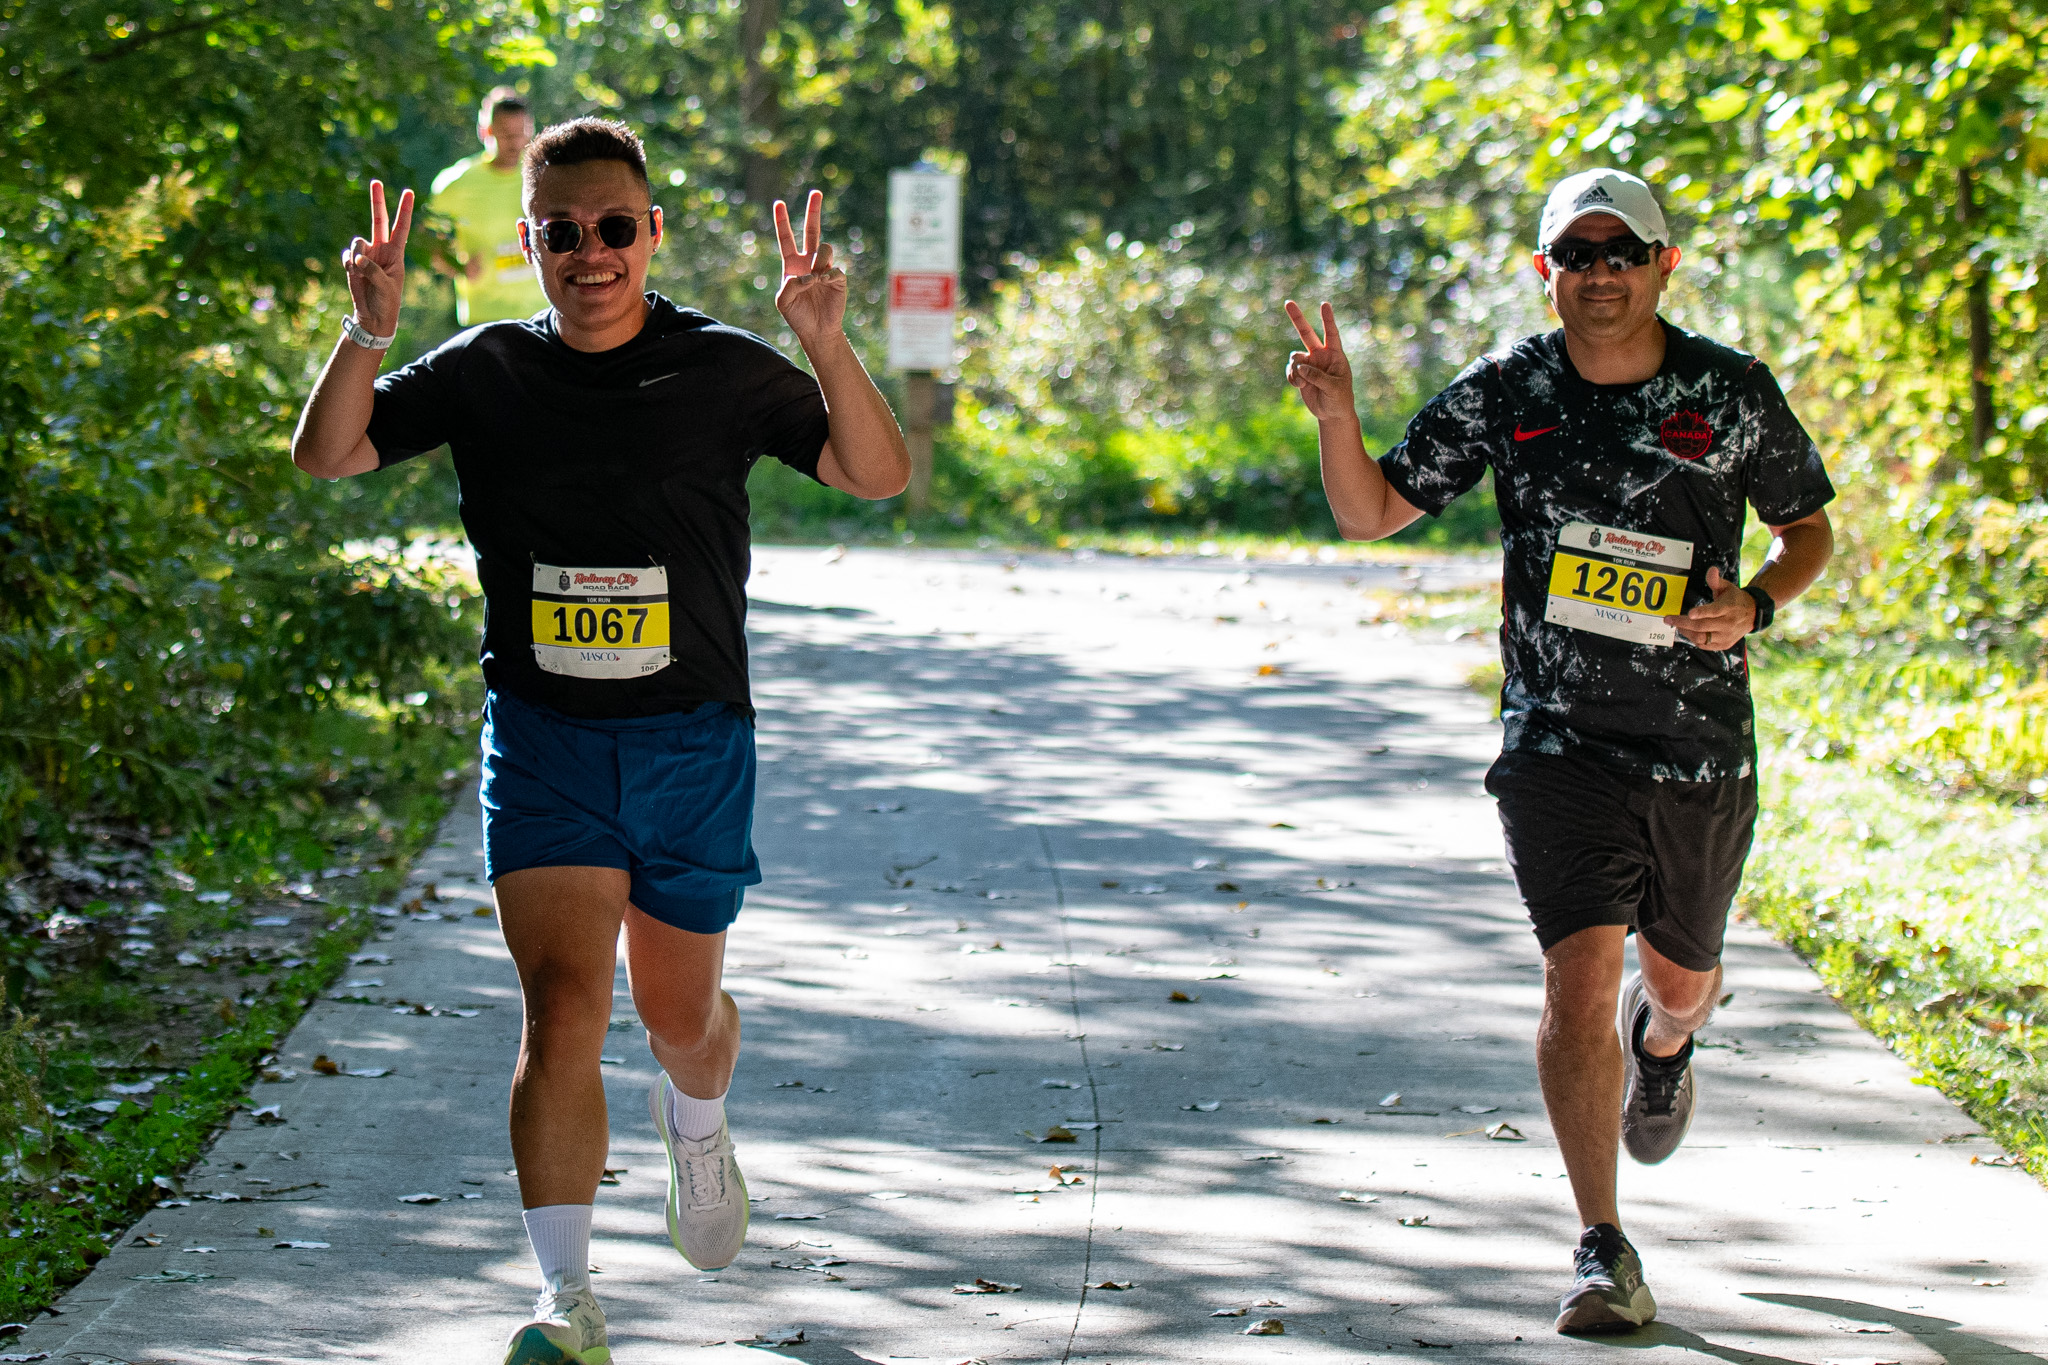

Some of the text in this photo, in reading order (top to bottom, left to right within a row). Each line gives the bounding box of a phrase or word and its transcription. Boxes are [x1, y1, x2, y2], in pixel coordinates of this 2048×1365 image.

[1582, 196, 1613, 204] adidas
[1664, 431, 1707, 439] CANADA
[1604, 532, 1646, 551] Railway
[1645, 540, 1666, 555] City
[1612, 545, 1634, 554] ROAD
[1636, 549, 1656, 558] RACE
[1623, 559, 1636, 567] RUN
[574, 573, 639, 587] Railway City
[1571, 562, 1668, 612] 1260
[1594, 608, 1630, 624] MASCO
[553, 606, 649, 644] 1067
[580, 651, 616, 662] MASCO
